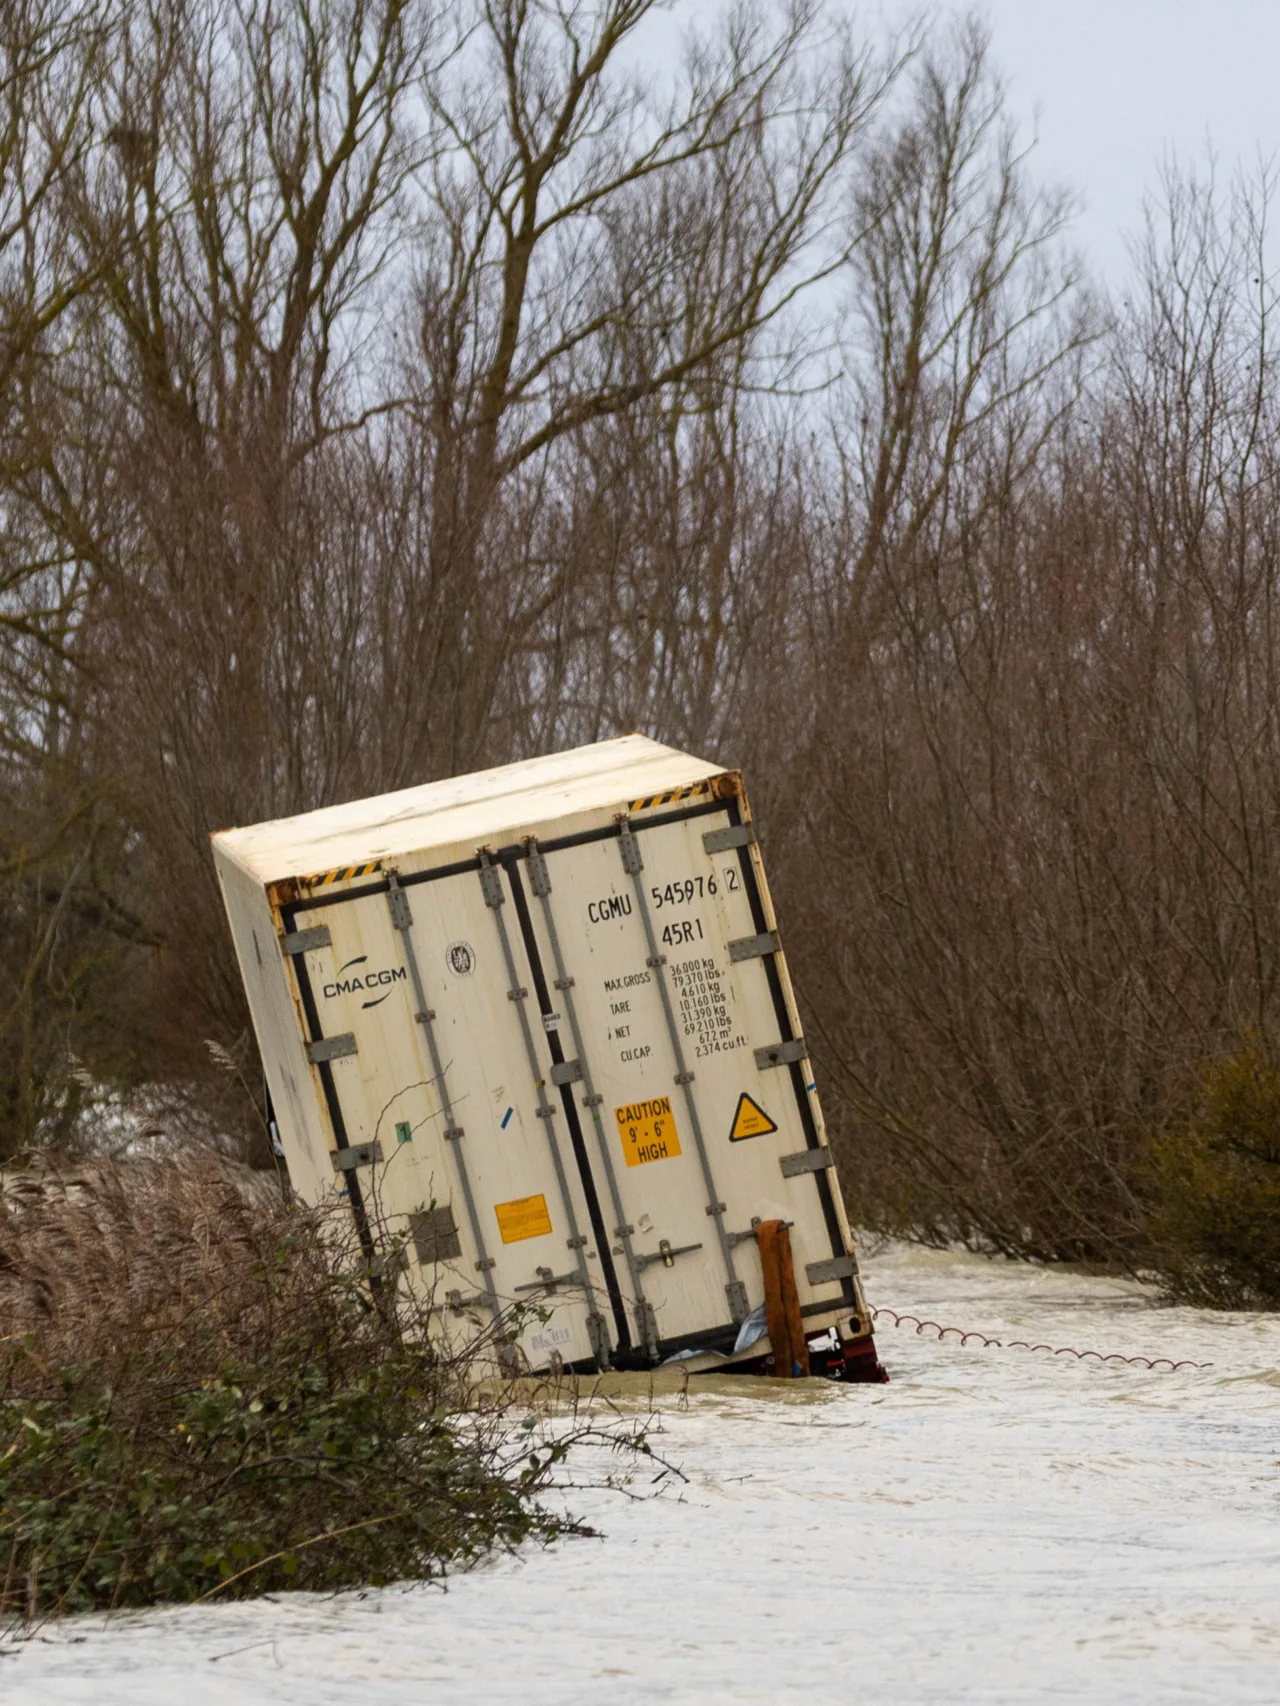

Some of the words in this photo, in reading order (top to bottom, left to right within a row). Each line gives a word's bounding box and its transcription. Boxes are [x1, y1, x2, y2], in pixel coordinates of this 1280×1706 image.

[588, 894, 632, 923] CGMU
[651, 874, 717, 909] 545976
[726, 869, 739, 891] 2
[662, 918, 704, 946] 45R1
[701, 957, 715, 970] kg
[704, 969, 721, 981] lbs
[323, 978, 364, 998] CMA
[365, 967, 407, 988] CGM
[707, 981, 721, 993] kg
[610, 1000, 631, 1015] TARE
[710, 992, 727, 1004] lbs
[713, 1004, 727, 1017] kg
[615, 1025, 631, 1039] NET
[716, 1016, 732, 1028] lbs
[616, 1097, 671, 1124] CAUTION
[638, 1142, 669, 1163] HIGH
